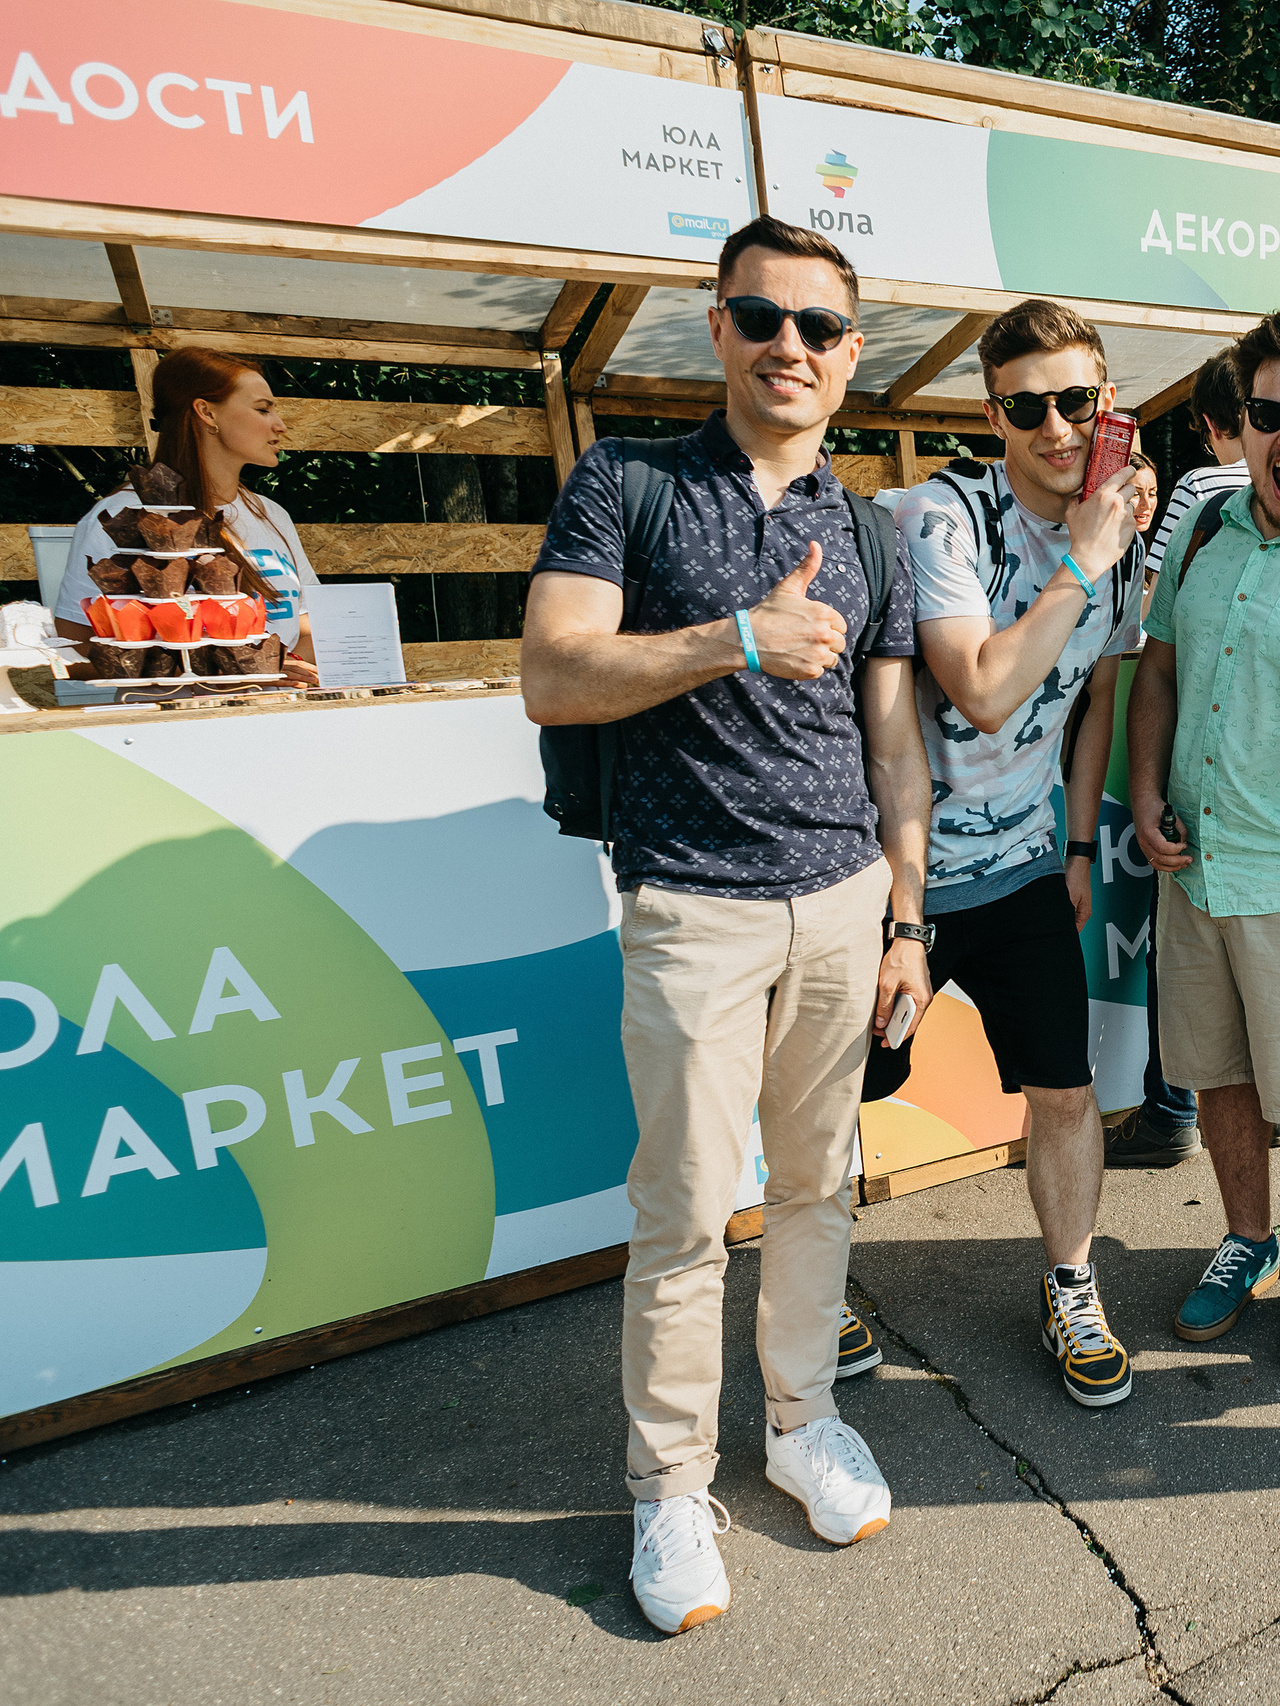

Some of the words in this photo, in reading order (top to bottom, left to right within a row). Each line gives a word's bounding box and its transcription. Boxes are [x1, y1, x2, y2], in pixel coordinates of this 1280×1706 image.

[662, 124, 721, 151] ЮЛА
[621, 148, 723, 180] МАРКЕТ
[809, 208, 874, 236] юла
[1140, 209, 1280, 260] ДЕКОР
